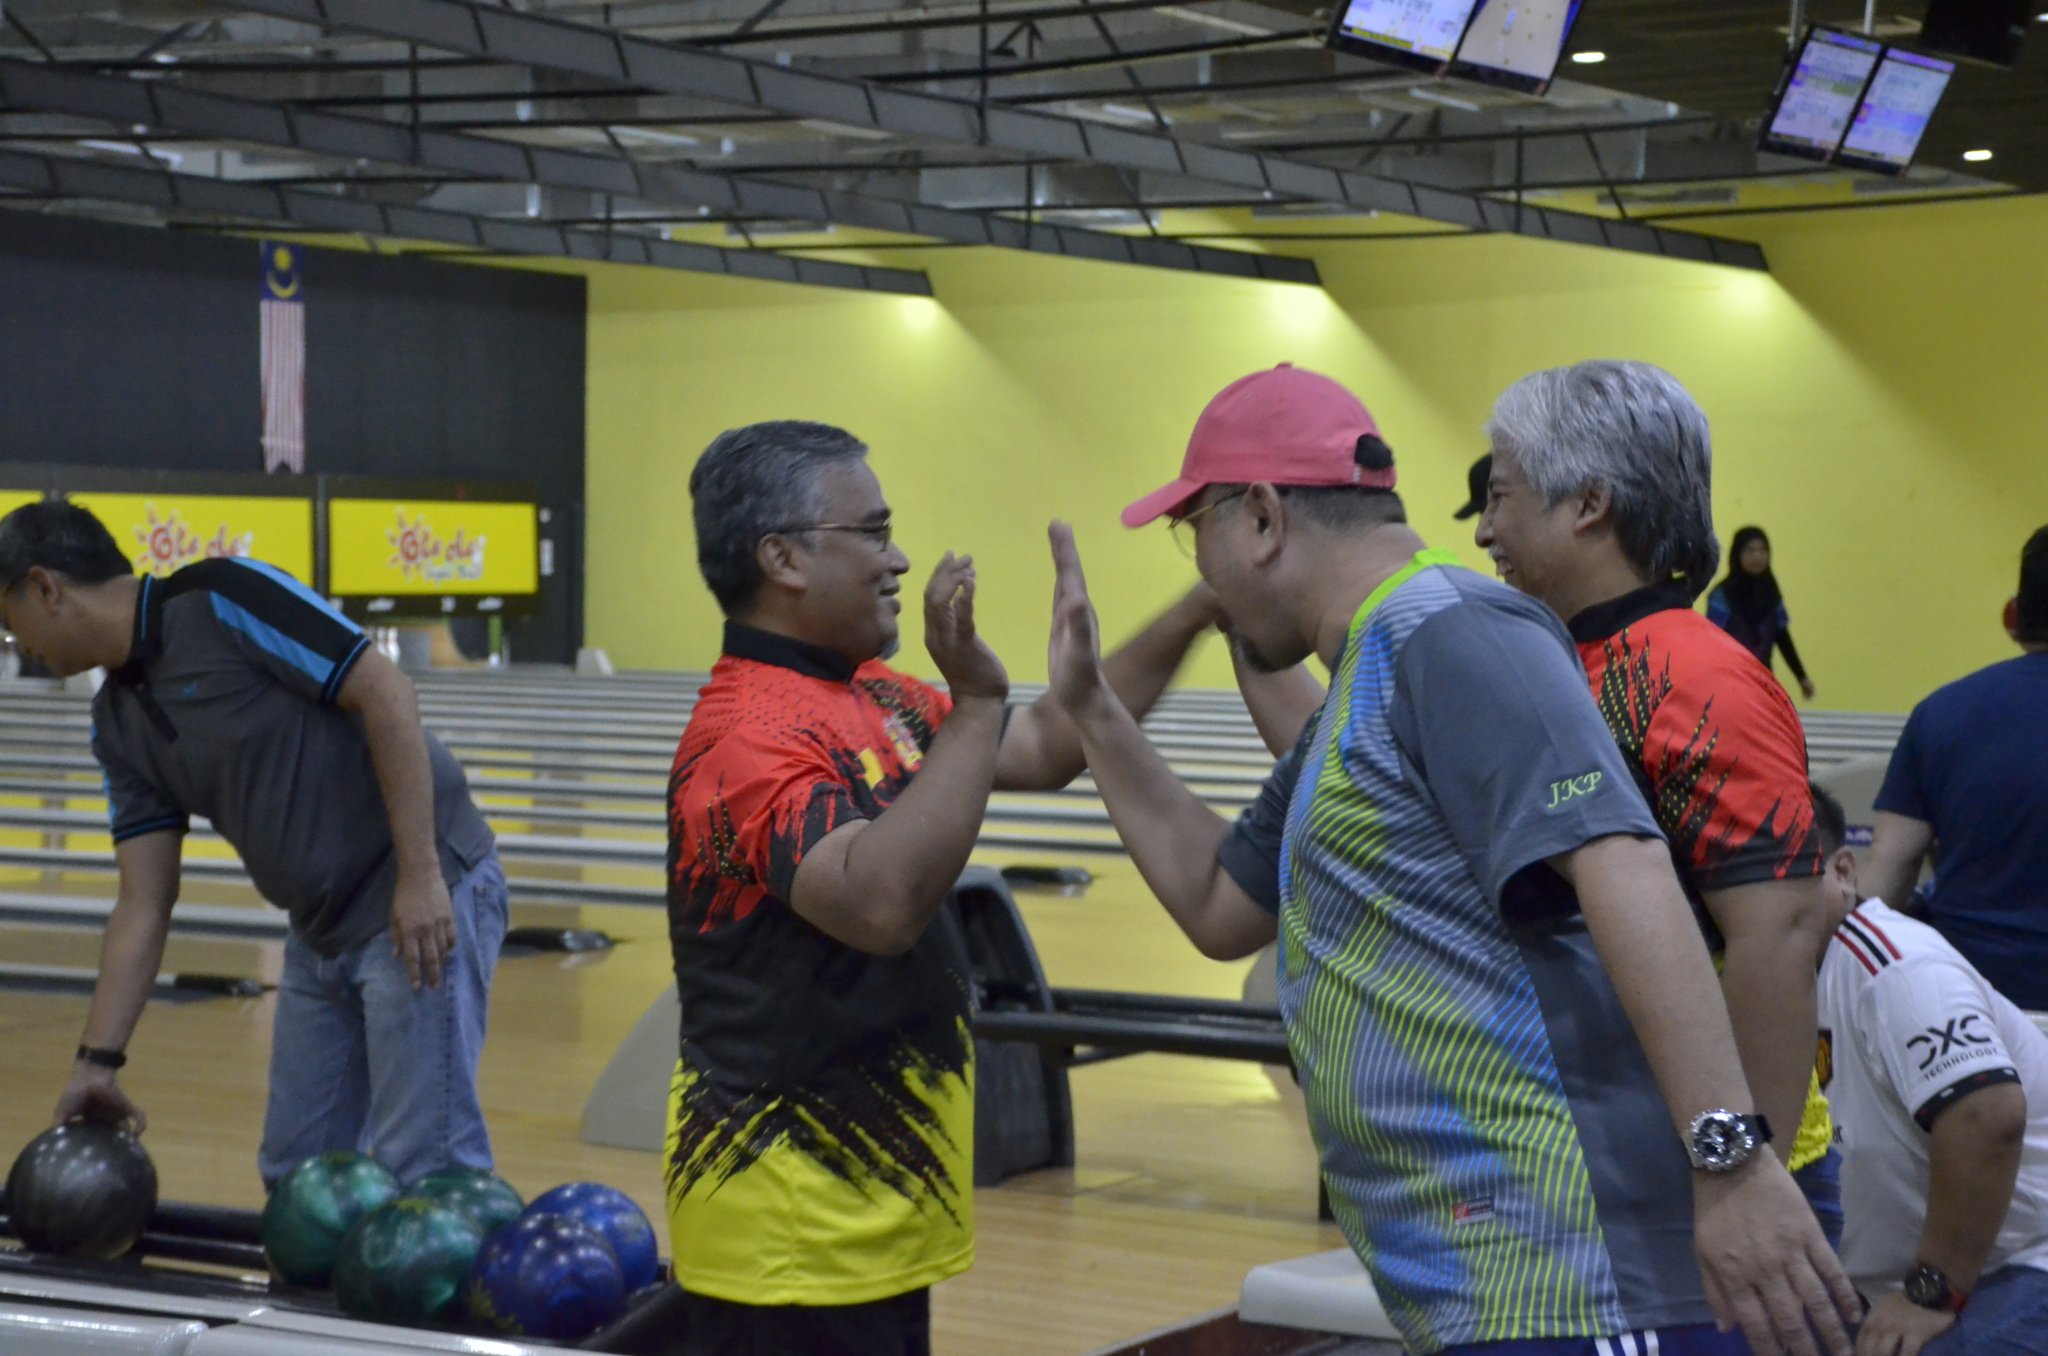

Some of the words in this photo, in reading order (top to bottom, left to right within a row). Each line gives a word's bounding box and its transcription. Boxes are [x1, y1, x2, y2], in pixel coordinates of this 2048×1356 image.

[1547, 770, 1602, 809] JKP
[1906, 1014, 1992, 1071] DXC
[1923, 1047, 1999, 1081] TECHNOLOGY
